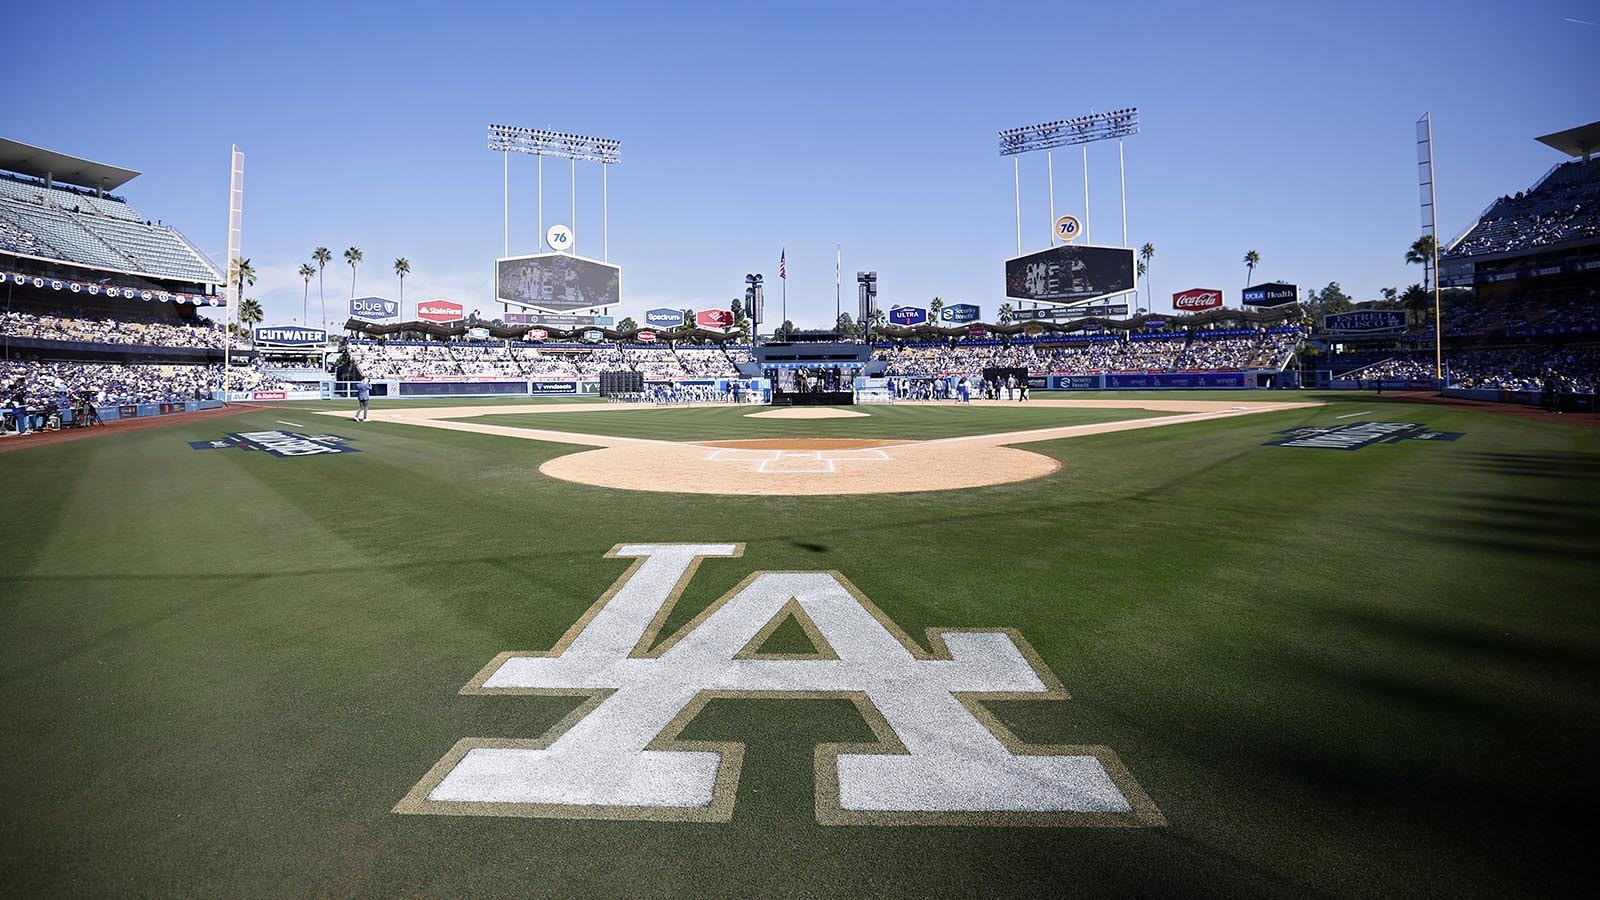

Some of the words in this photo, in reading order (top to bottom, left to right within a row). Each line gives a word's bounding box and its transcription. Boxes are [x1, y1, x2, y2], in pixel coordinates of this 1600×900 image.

[1060, 221, 1075, 233] 76
[554, 232, 567, 243] 76
[1267, 290, 1293, 299] Health
[353, 299, 381, 312] blue
[954, 307, 976, 315] Security
[648, 313, 679, 322] Spectrum
[1331, 319, 1384, 329] JALISCO
[259, 329, 323, 341] CUTWATER
[393, 543, 1166, 826] LA
